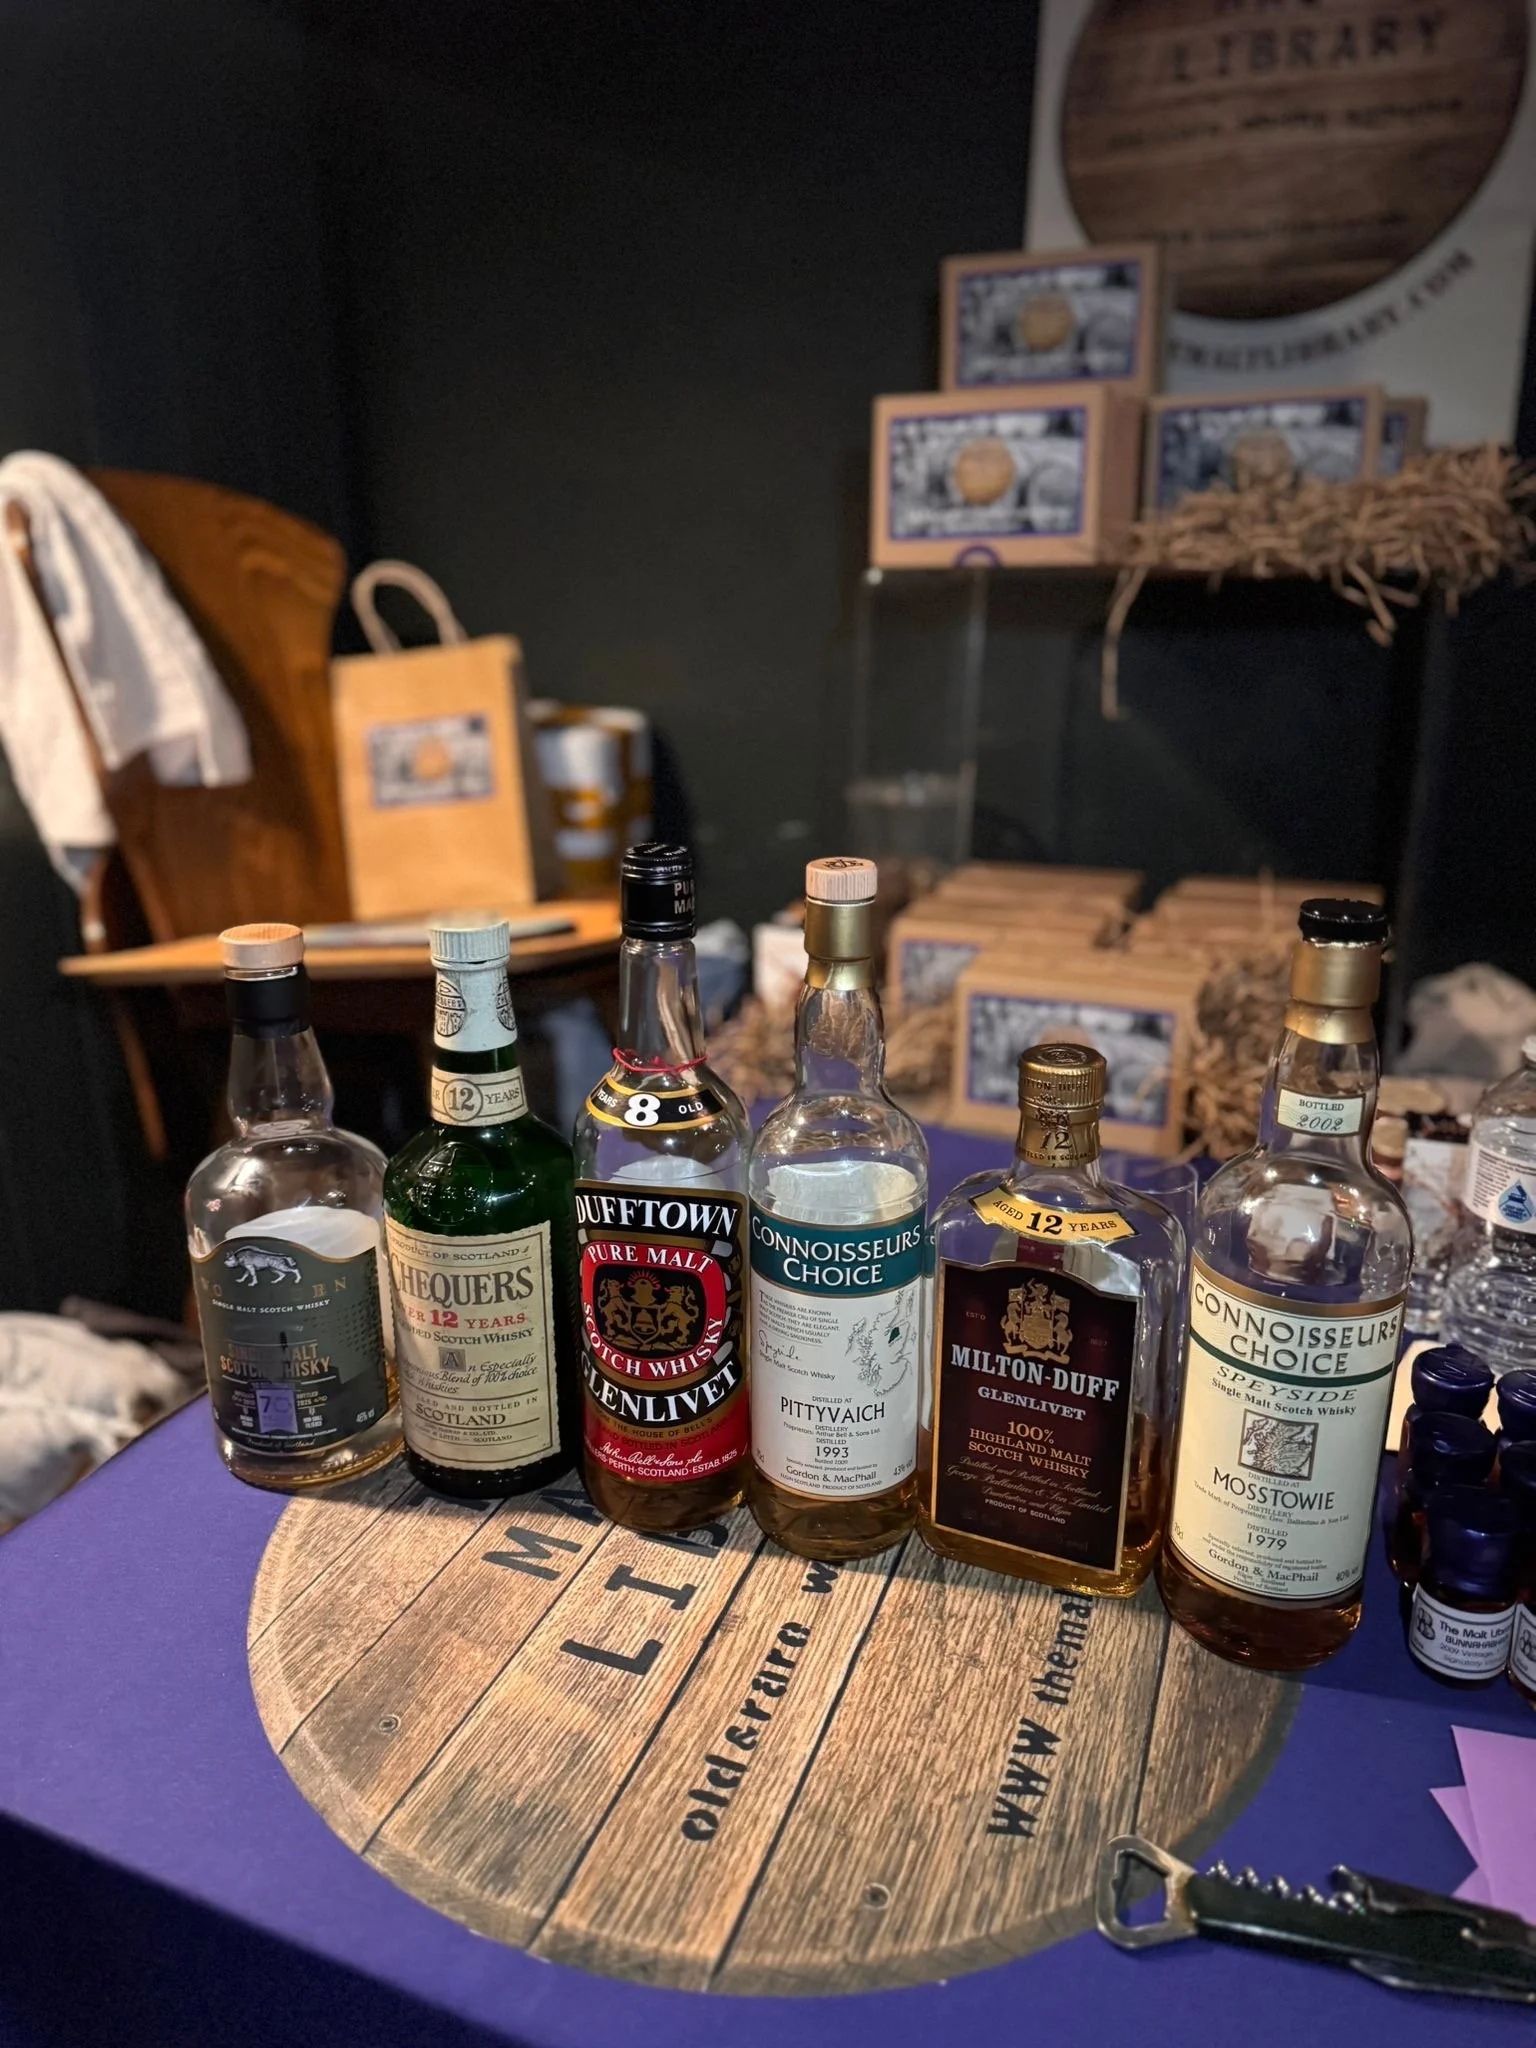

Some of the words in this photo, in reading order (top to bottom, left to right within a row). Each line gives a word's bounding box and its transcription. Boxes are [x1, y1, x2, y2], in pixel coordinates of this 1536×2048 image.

[1171, 11, 1447, 82] LIBRARY
[448, 1087, 475, 1111] 12
[484, 1087, 520, 1105] YEARS
[597, 1088, 618, 1108] YEARS
[624, 1093, 661, 1127] 8
[678, 1103, 704, 1115] OLD
[1299, 1099, 1345, 1112] BOTTLED
[1041, 1131, 1073, 1150] 12
[575, 1195, 738, 1237] DUFFTOWN
[993, 1200, 1024, 1221] AGED
[1026, 1211, 1063, 1235] 12
[1069, 1220, 1117, 1232] YEARS
[752, 1215, 921, 1262] CONNOISSEURS
[433, 1252, 449, 1260] OF
[453, 1248, 520, 1260] SCOTLAND
[587, 1243, 639, 1264] PURE
[646, 1248, 713, 1274] MALT
[391, 1252, 533, 1308] CHEQUERS
[783, 1258, 883, 1286] CHOICE
[260, 1306, 293, 1314] SCOTCH
[297, 1299, 330, 1311] WHISKY
[430, 1309, 458, 1329] 12
[466, 1313, 526, 1329] YEARS
[1194, 1282, 1398, 1349] CONNOISSEURS
[583, 1301, 642, 1377] SCOTCH
[648, 1317, 723, 1377] WHISKY
[480, 1353, 537, 1373] Especially
[1230, 1334, 1349, 1375] CHOICE
[439, 1370, 470, 1384] Blend
[472, 1375, 483, 1387] of
[507, 1365, 538, 1381] choice
[581, 1351, 738, 1422] GLENLIVET
[787, 1365, 808, 1376] Scotch
[810, 1370, 835, 1380] Whisky
[951, 1344, 1120, 1402] MILTON-DUFF
[1216, 1365, 1358, 1403] SPEYSIDE
[472, 1401, 521, 1412] BOTTLED
[526, 1396, 538, 1405] IN
[781, 1396, 885, 1424] PITTYVAICH
[977, 1387, 1086, 1421] GLENLIVET
[1212, 1377, 1241, 1399] Single
[1244, 1393, 1270, 1410] Malt
[1274, 1402, 1313, 1416] Scotch
[1318, 1404, 1357, 1417] Whisky
[416, 1403, 507, 1426] SCOTLAND
[633, 1429, 664, 1439] HOUSE
[668, 1430, 679, 1438] OF
[1007, 1421, 1055, 1445] 100%
[816, 1446, 849, 1459] 1993
[968, 1441, 1023, 1463] SCOTCH
[1028, 1455, 1090, 1480] WHISKY
[970, 1428, 1047, 1455] HIGHLAND
[1050, 1447, 1092, 1467] MALT
[786, 1465, 820, 1481] Gordon
[822, 1473, 831, 1483] &
[834, 1470, 877, 1483] MacPhail
[943, 1464, 978, 1481] George
[1213, 1467, 1336, 1511] MOSSTOWIE
[985, 1498, 1017, 1511] PRODUCT
[1018, 1506, 1028, 1514] OF
[1030, 1510, 1066, 1525] SCOTLAND
[1246, 1522, 1289, 1538] DISTILLED
[1247, 1532, 1288, 1551] 1979
[1208, 1548, 1249, 1574] Gordon
[1252, 1566, 1263, 1577] &
[1267, 1570, 1319, 1583] MacPhail
[1439, 1621, 1459, 1635] The
[1463, 1628, 1488, 1639] Malt
